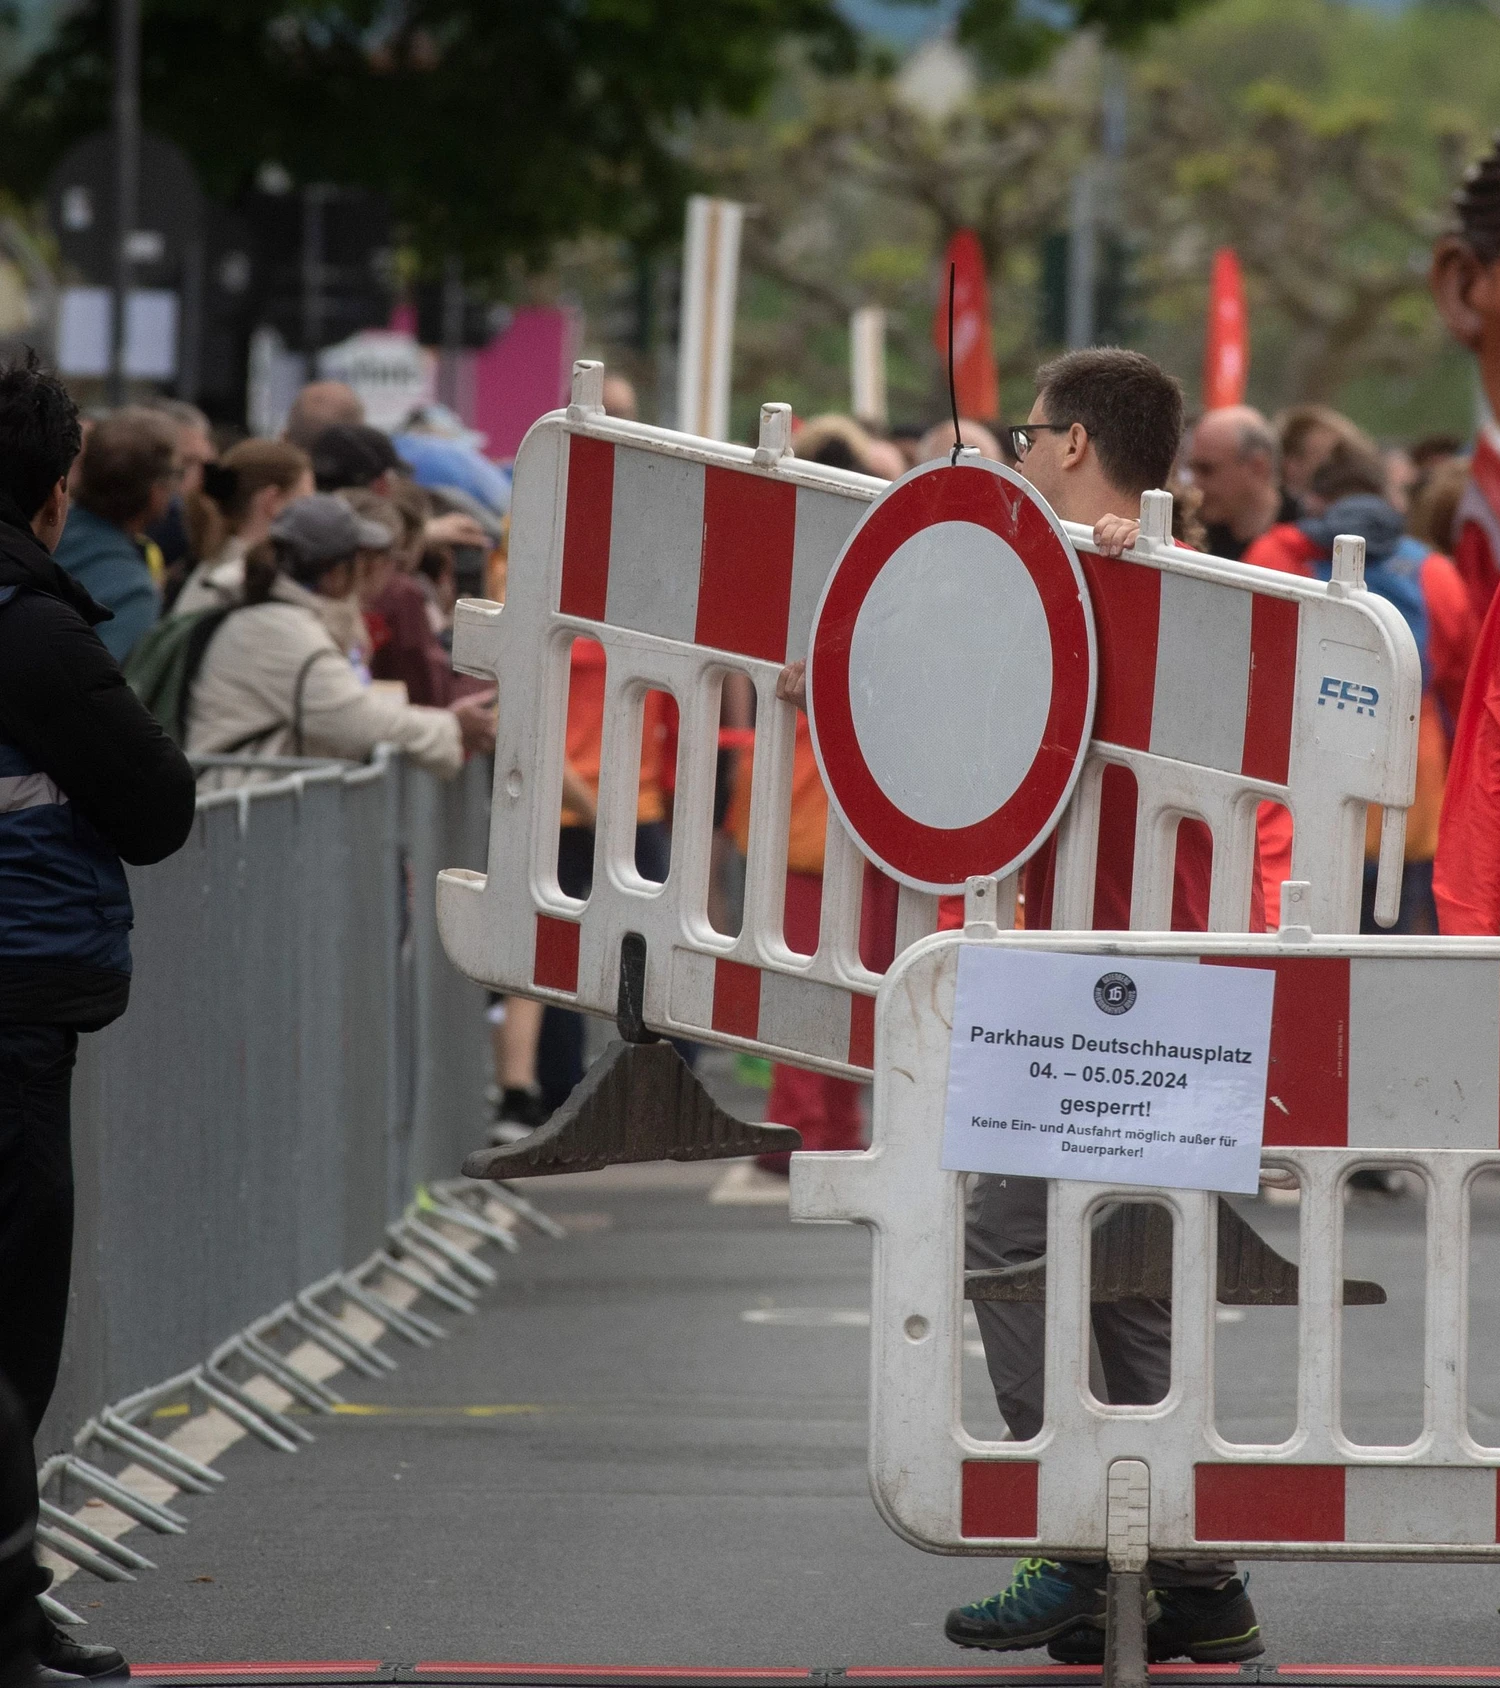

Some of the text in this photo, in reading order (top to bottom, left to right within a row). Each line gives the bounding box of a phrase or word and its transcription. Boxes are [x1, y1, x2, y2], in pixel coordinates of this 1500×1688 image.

[970, 1026, 1253, 1065] Parkhaus Deutschhausplatz
[1029, 1062, 1057, 1080] 04.
[1082, 1066, 1188, 1089] 05.05.2024
[1060, 1098, 1151, 1117] gesperrt!
[971, 1116, 1238, 1147] Keine Ein- und Ausfahrt möglich außer für
[1061, 1141, 1144, 1157] Dauerparker!
